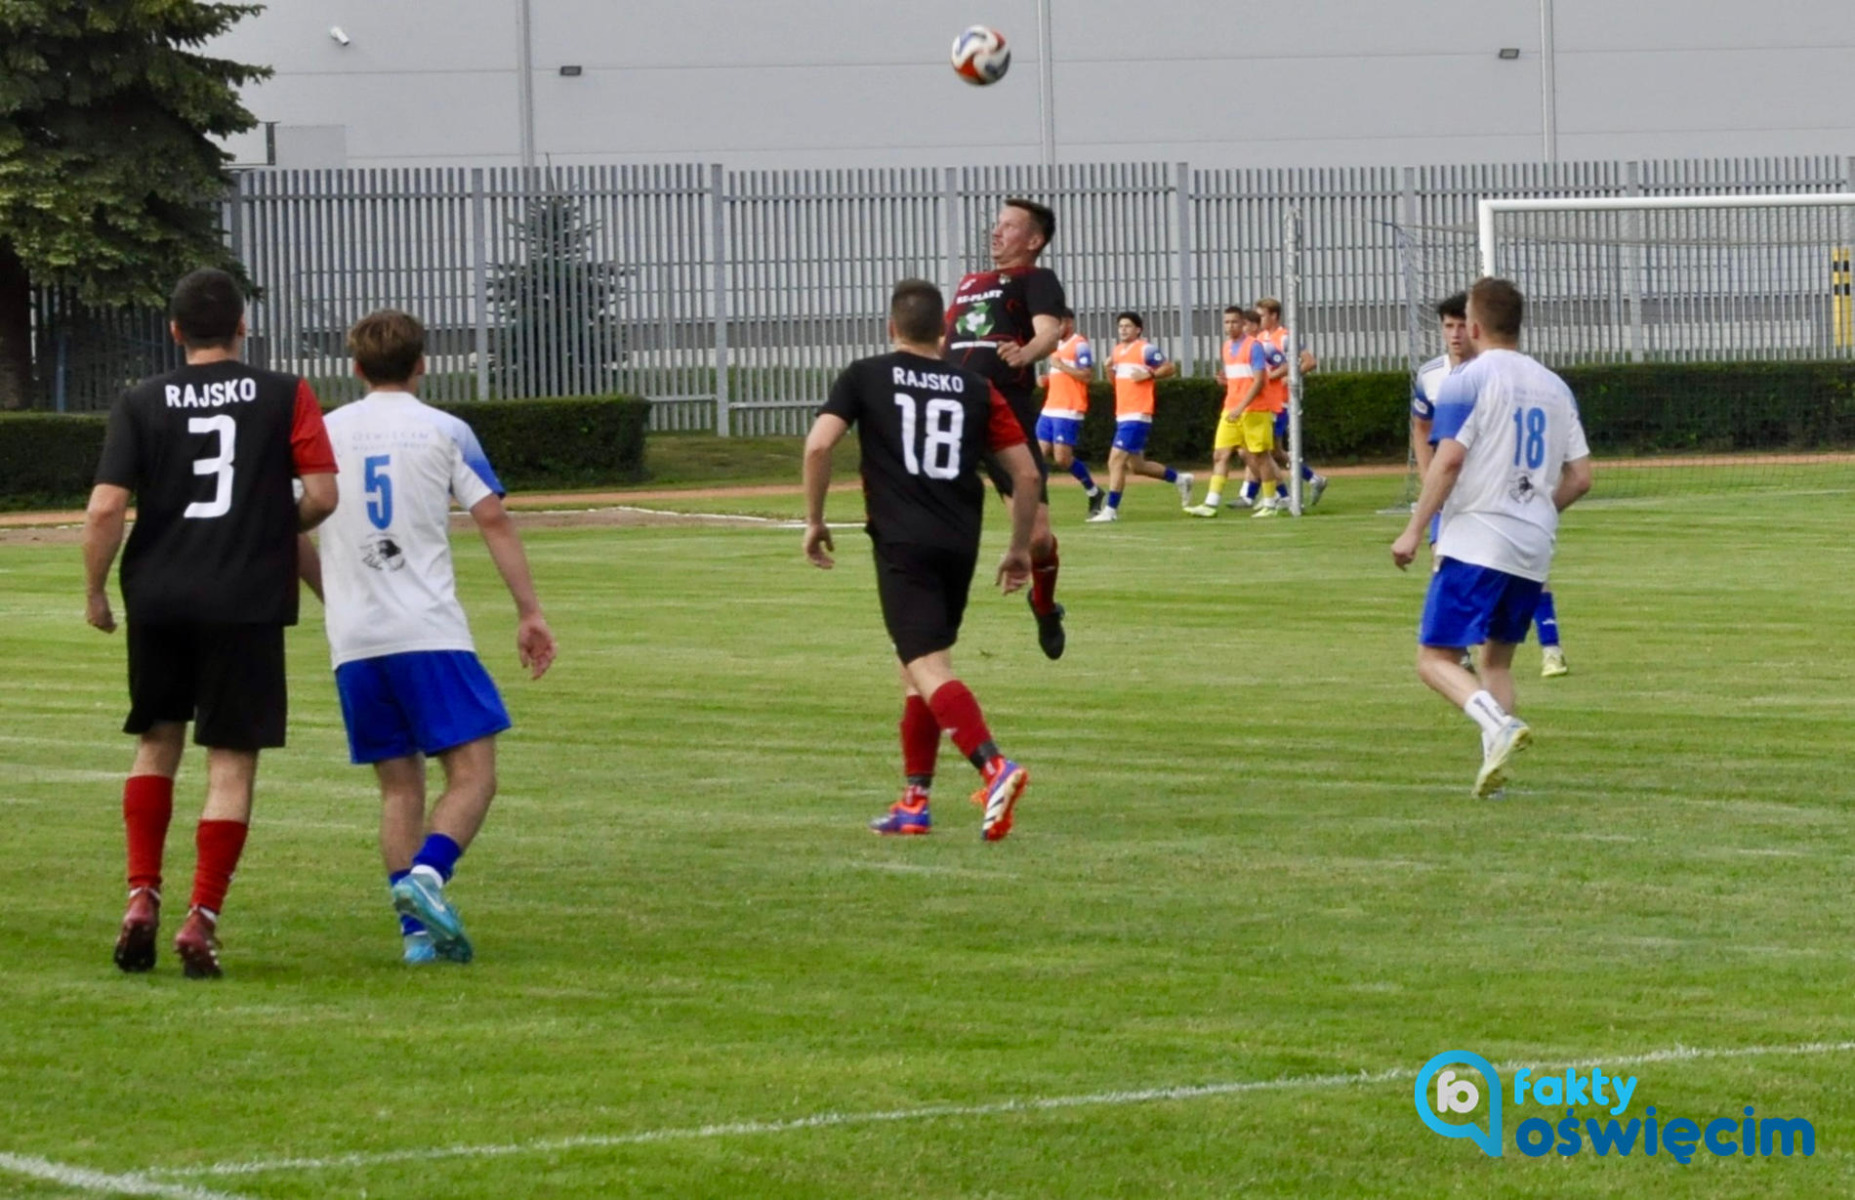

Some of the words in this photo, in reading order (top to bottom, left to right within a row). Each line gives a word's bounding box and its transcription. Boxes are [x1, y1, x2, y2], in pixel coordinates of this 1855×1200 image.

[165, 377, 256, 408] RAJSKO
[893, 366, 964, 393] RAJSKO
[184, 414, 236, 518] 3
[894, 391, 965, 480] 18
[1513, 406, 1547, 469] 18
[364, 454, 393, 530] 5
